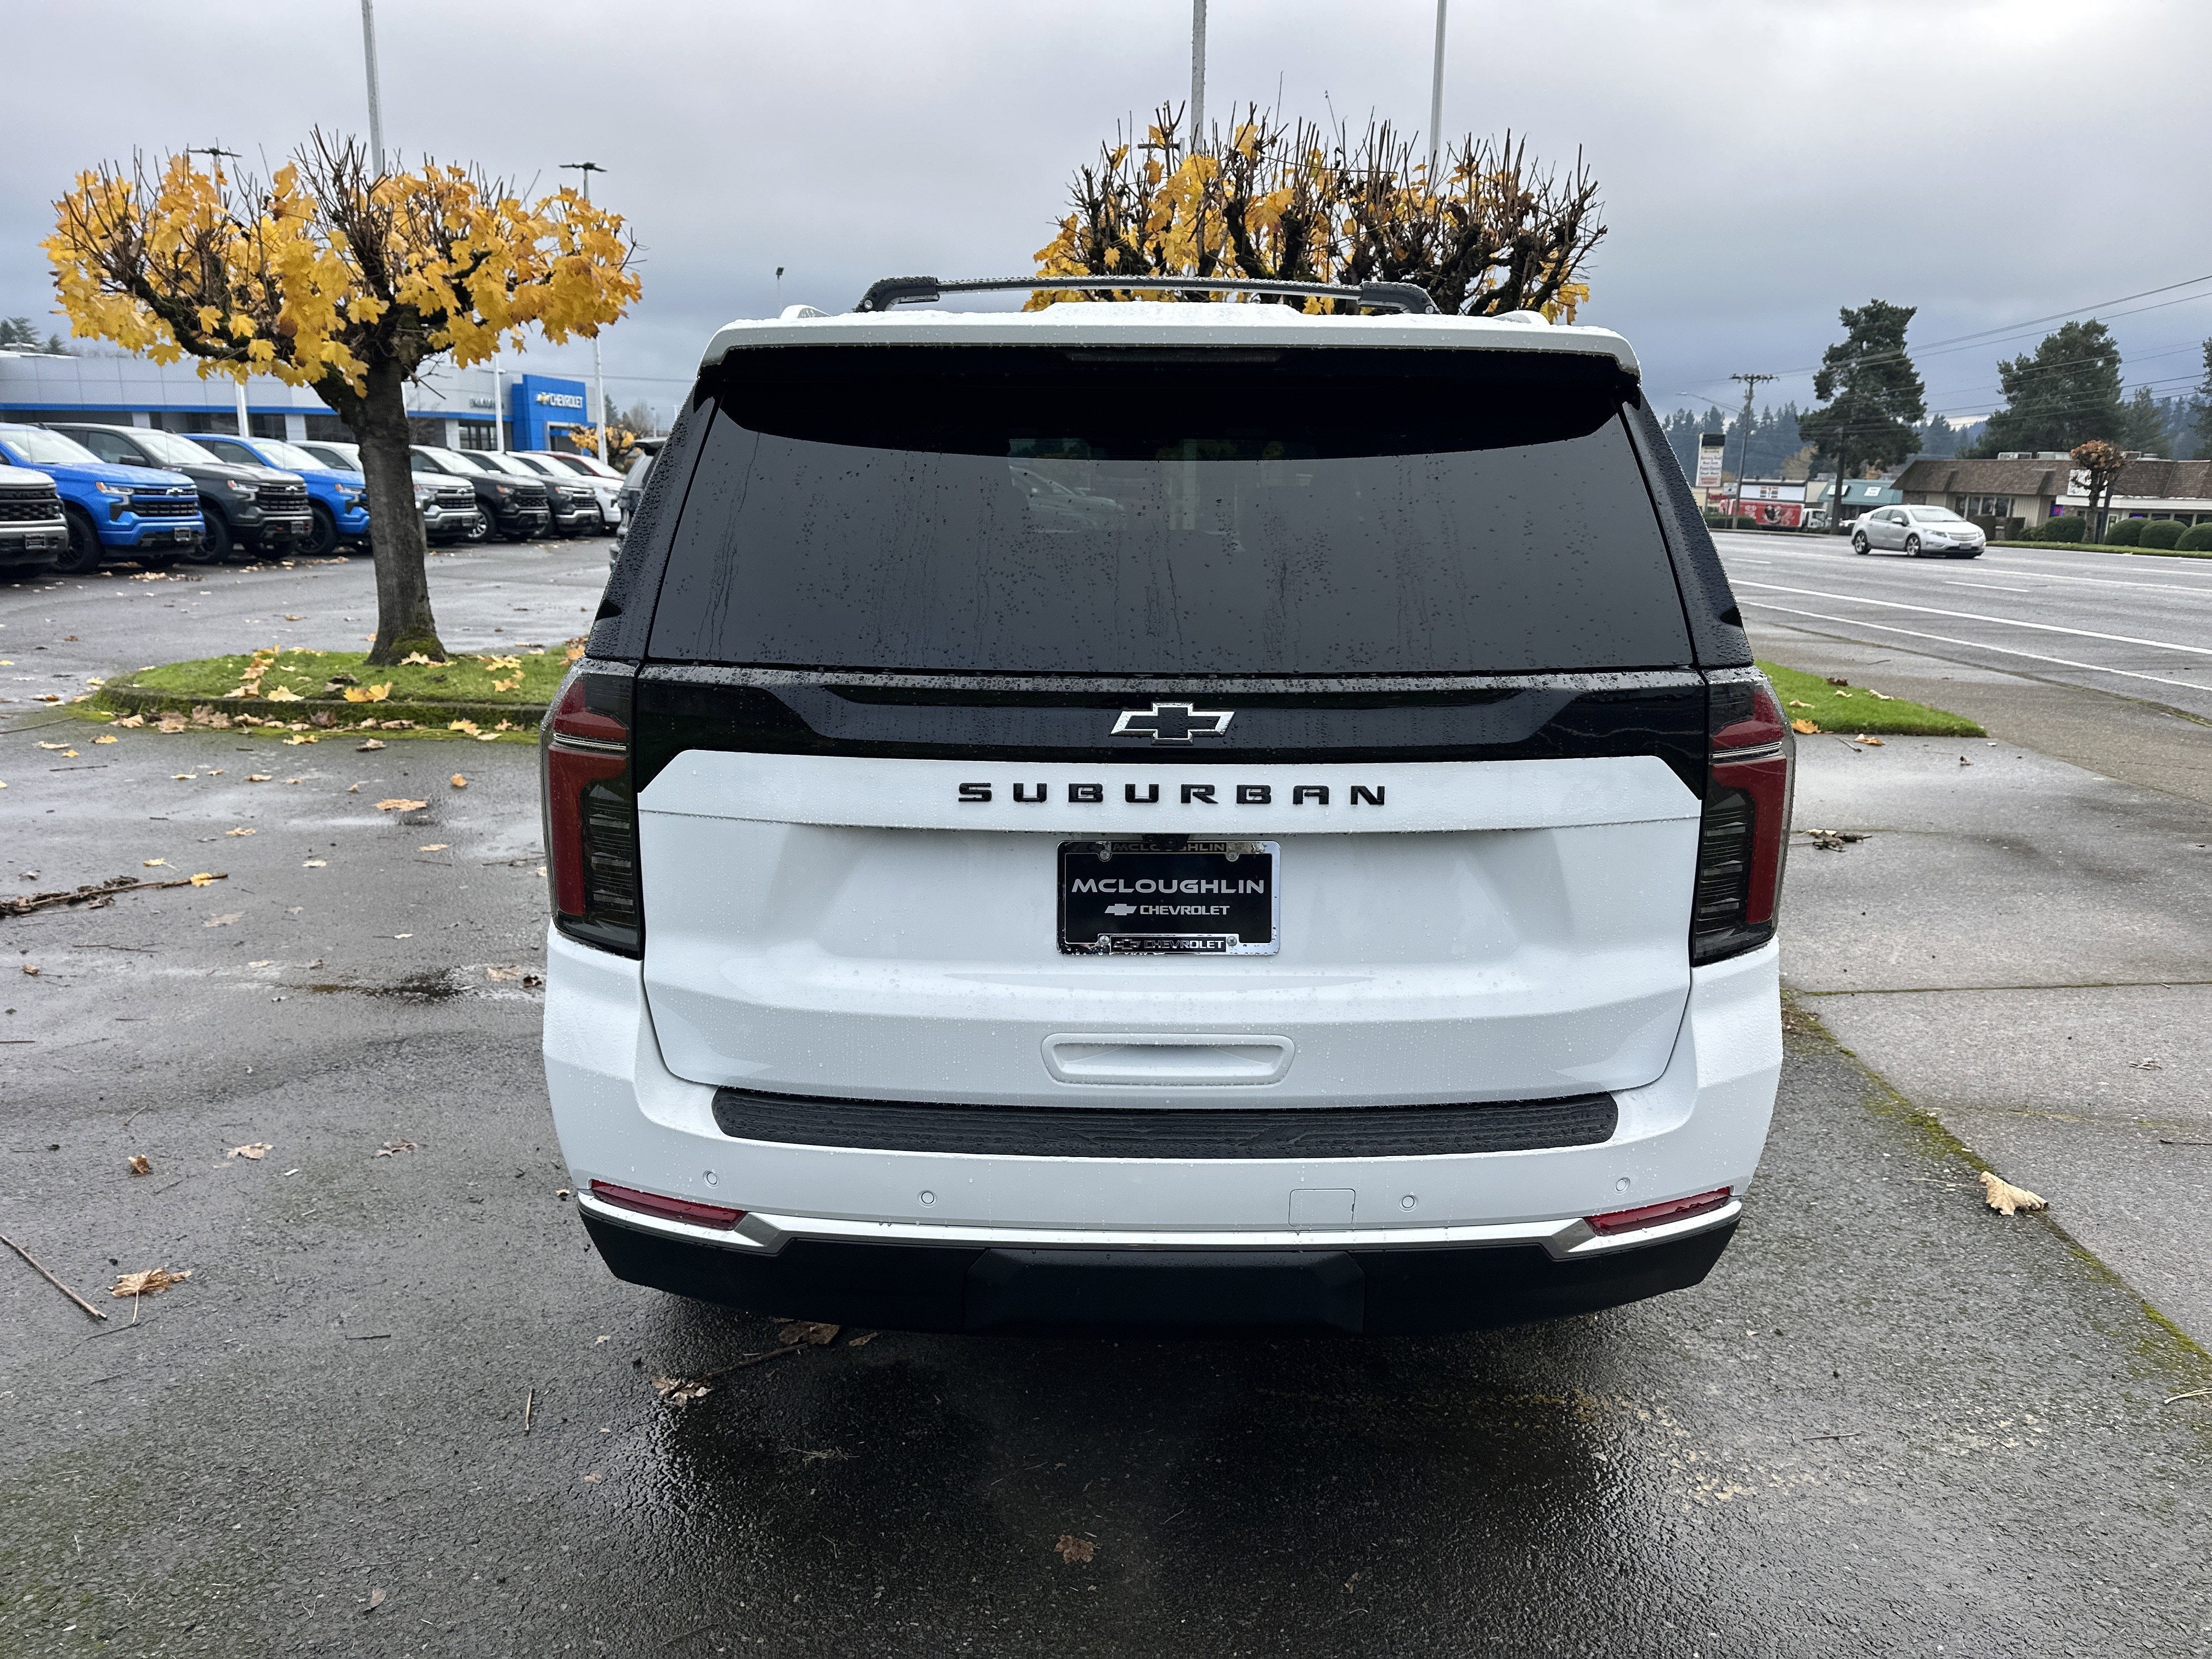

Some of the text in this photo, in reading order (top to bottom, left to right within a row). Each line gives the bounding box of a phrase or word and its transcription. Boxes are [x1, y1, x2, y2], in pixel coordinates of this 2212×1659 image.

[549, 393, 583, 408] CHEVROLET
[958, 782, 1385, 806] SUBURBAN
[1113, 843, 1225, 851] MCLOHLIN
[1071, 878, 1264, 894] MCLOUGHLIN
[1139, 905, 1230, 915] CHEVROLET
[1143, 940, 1224, 950] CHEVROLET
